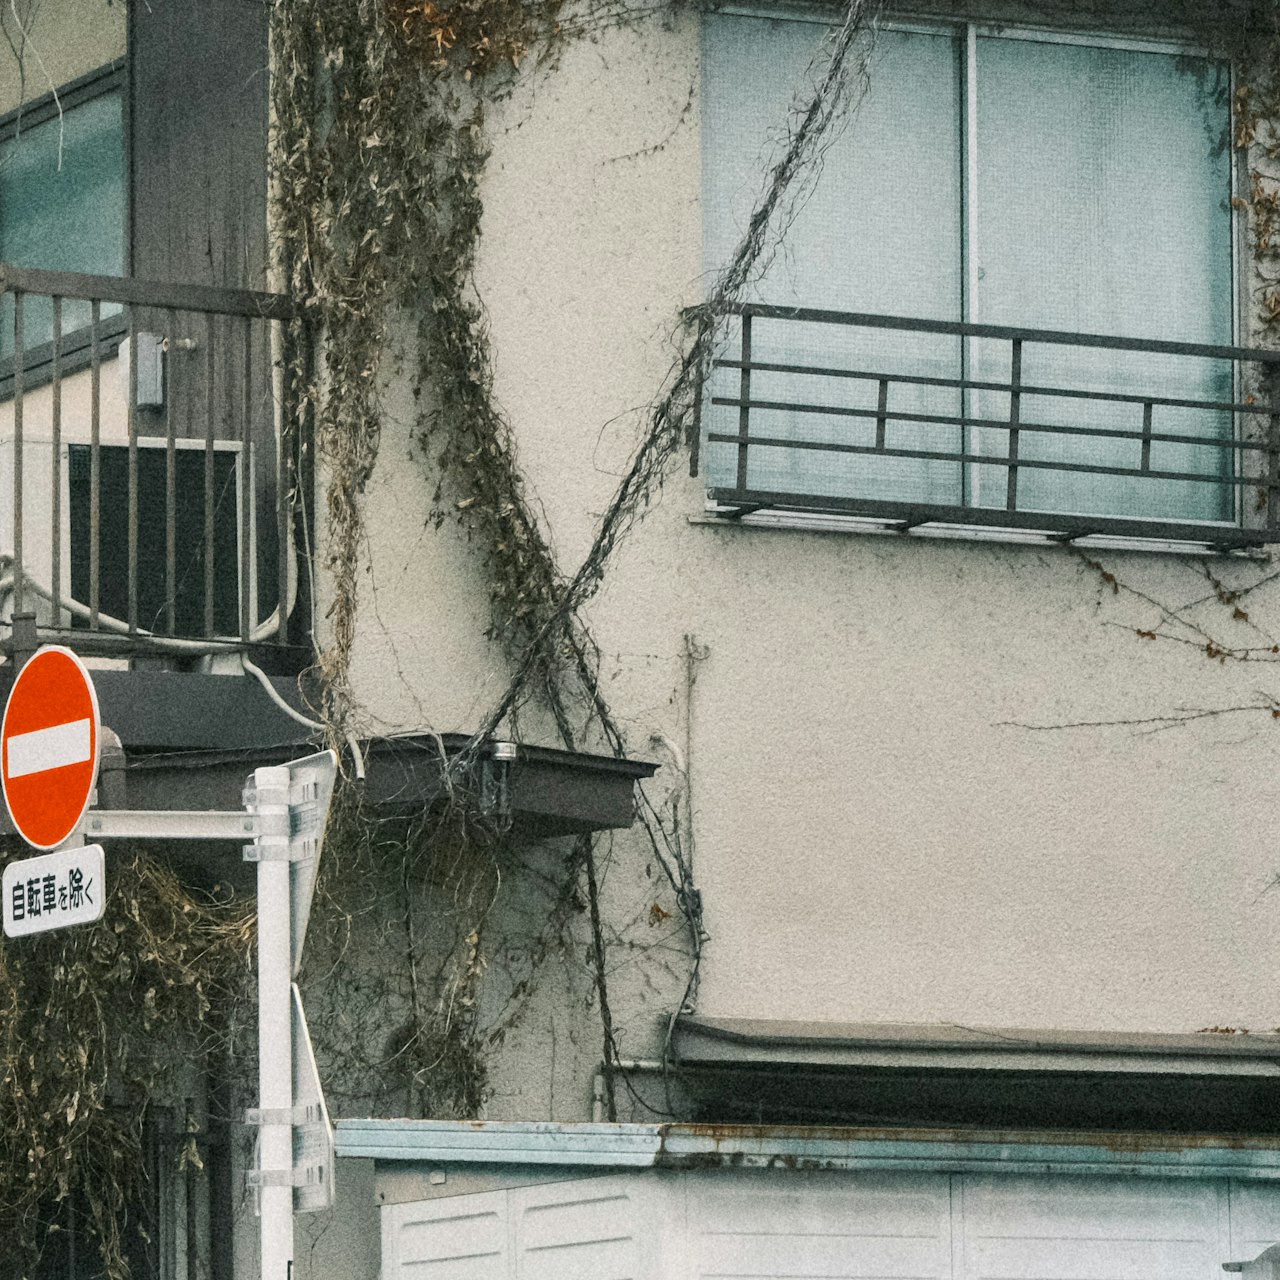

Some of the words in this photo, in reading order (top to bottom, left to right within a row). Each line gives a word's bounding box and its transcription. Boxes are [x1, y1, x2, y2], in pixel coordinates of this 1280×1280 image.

[12, 867, 94, 921] 自転車を除く
